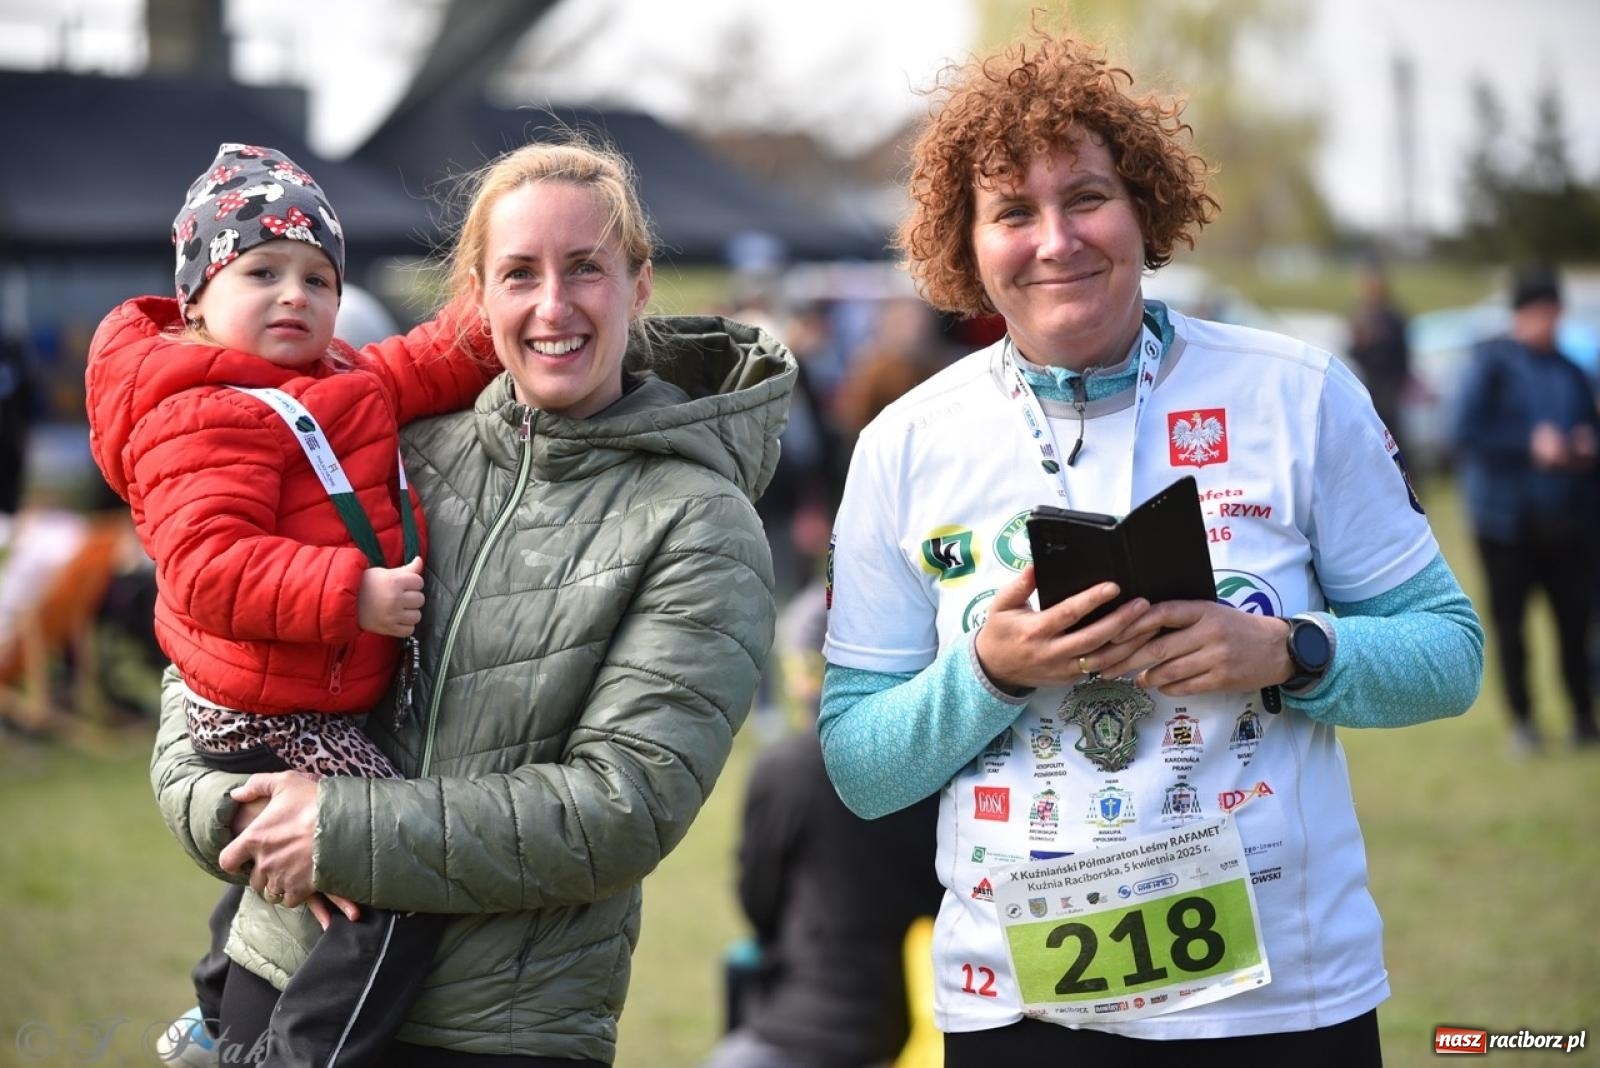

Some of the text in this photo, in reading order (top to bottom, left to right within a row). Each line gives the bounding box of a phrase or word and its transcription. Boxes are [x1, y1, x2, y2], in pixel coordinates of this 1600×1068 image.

[1219, 503, 1272, 519] RZYM
[1204, 526, 1232, 543] 16
[1010, 825, 1221, 881] X Kuźniański Półmaraton Leśny RAFAMET
[1028, 844, 1211, 892] Kuźnia Raciborska, 5 kwietnia 2025 r.
[1250, 871, 1282, 885] OWSKI
[1045, 896, 1226, 994] 218
[961, 963, 997, 998] 12
